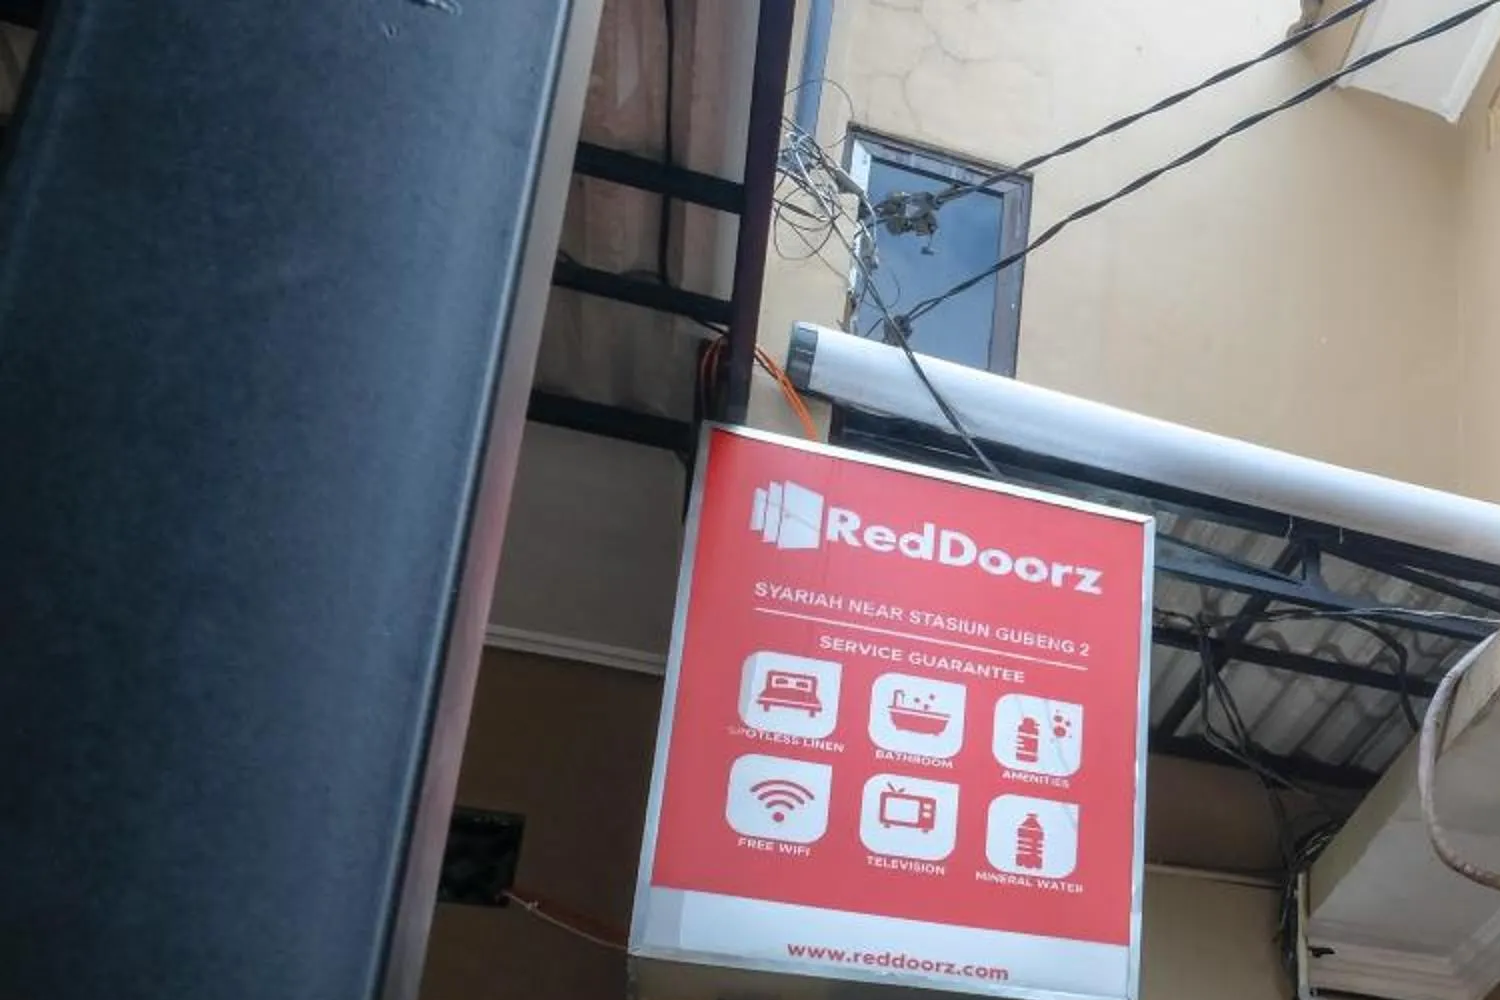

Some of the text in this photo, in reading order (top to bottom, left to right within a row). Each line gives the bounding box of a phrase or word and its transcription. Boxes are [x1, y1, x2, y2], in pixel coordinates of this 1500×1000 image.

[825, 507, 1103, 595] RedDoorz
[754, 582, 1090, 657] SYARIAH NEAR STASIUN GUBENG 2
[819, 635, 1026, 683] SERVICE GUARANTEE
[727, 725, 845, 754] SPOTLESS LINEN
[874, 749, 954, 769] BATHROOM
[1001, 770, 1070, 789] AMENITIES
[737, 837, 812, 857] FREE WIFI
[866, 855, 946, 877] TELEVISION
[975, 870, 1084, 895] MINERAL WATER
[787, 941, 1009, 982] www.reddoorz.com
